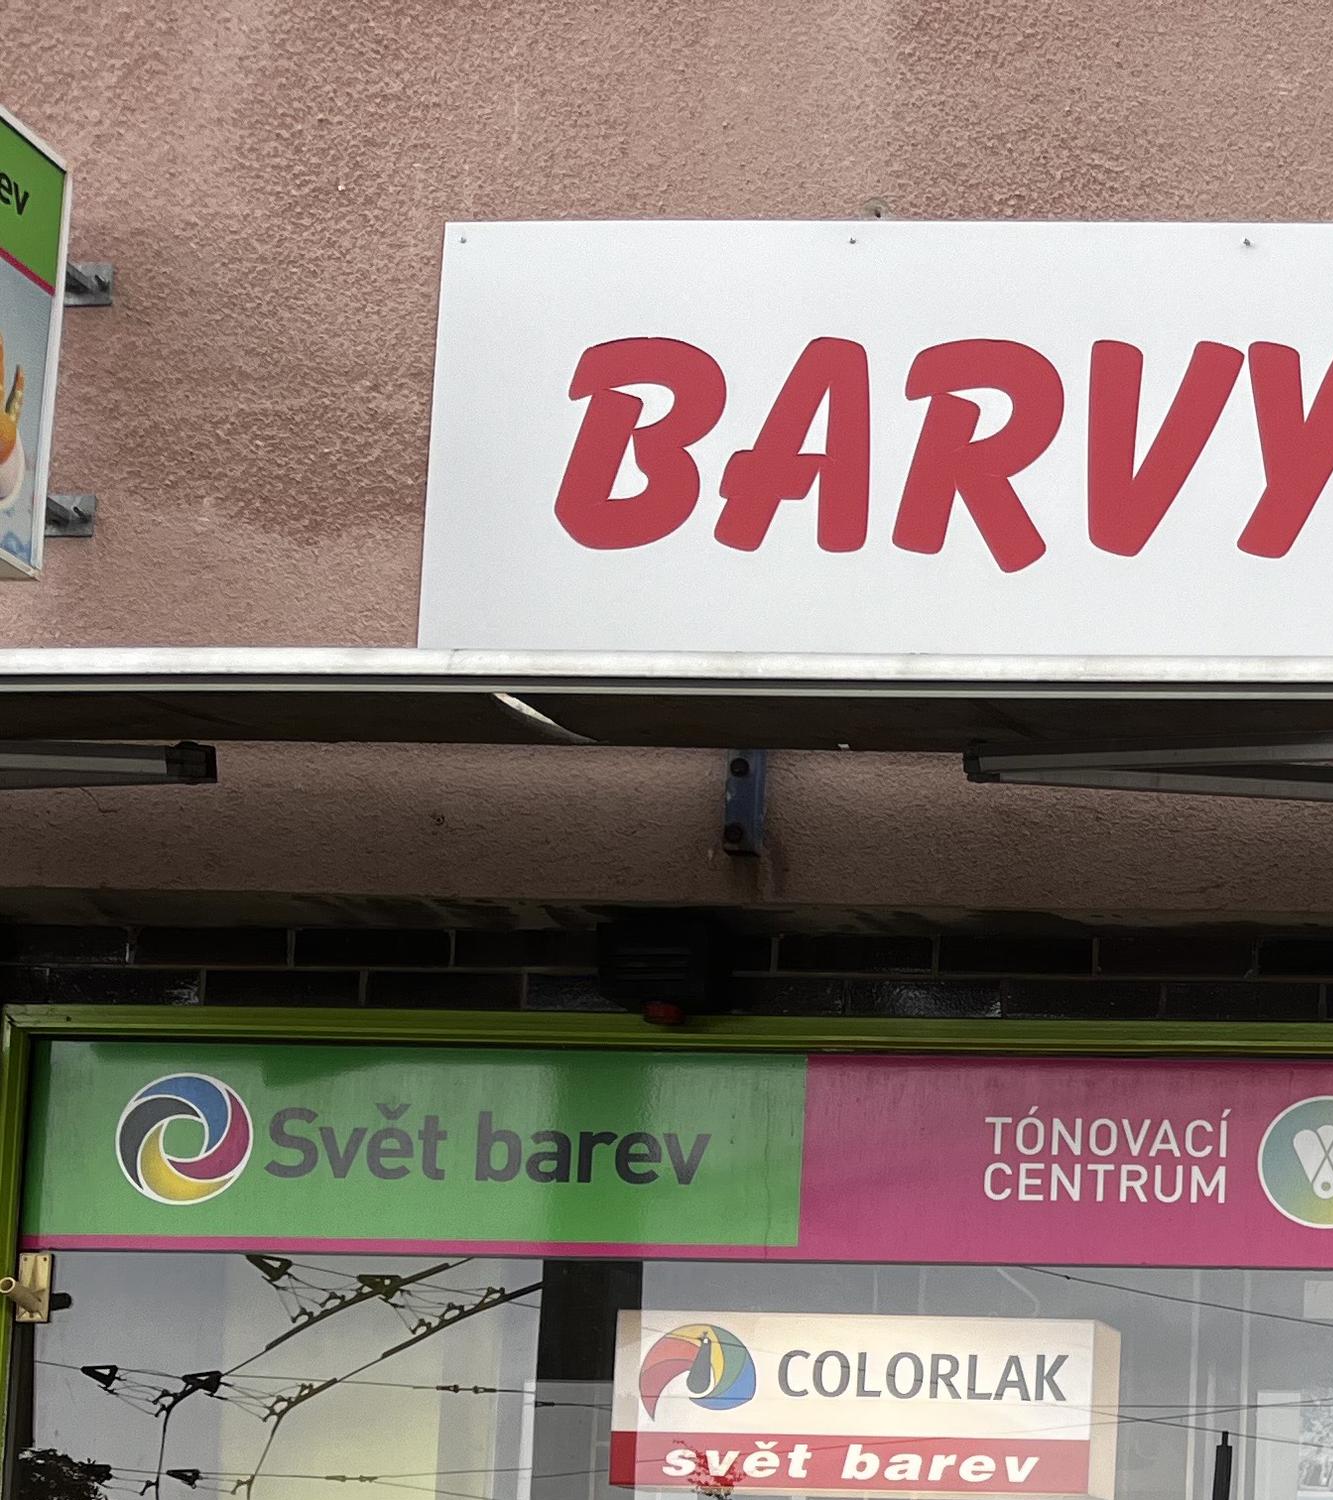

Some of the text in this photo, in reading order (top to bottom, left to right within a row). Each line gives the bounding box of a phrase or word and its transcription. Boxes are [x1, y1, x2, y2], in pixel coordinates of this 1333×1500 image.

[264, 1102, 711, 1186] Svět barev
[984, 1105, 1232, 1159] TÓNOVACÍ
[982, 1161, 1227, 1205] CENTRUM
[777, 1349, 1070, 1403] COLORLAK
[662, 1440, 1041, 1485] svět barev
